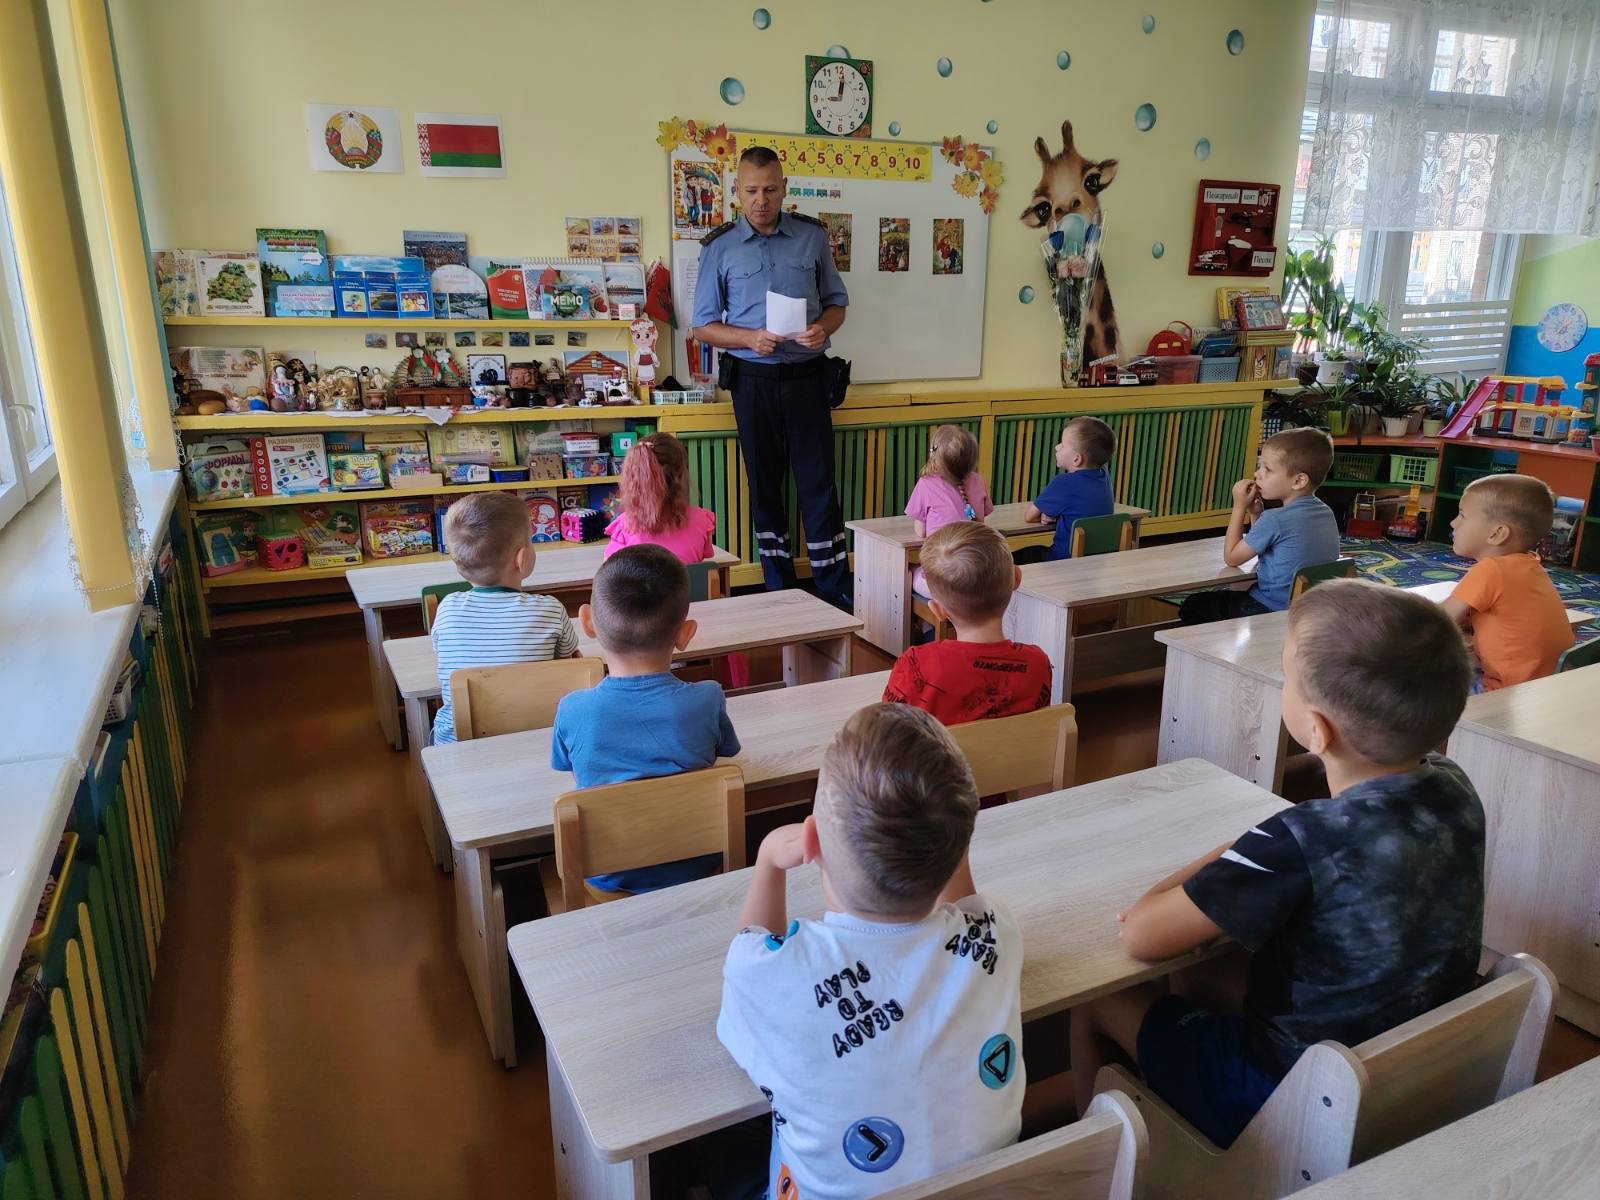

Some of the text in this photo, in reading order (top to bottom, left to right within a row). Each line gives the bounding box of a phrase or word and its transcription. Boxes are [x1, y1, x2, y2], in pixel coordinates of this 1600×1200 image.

[823, 69, 831, 77] 11
[835, 66, 844, 75] 12
[813, 80, 823, 88] 10
[859, 83, 863, 91] 2
[813, 95, 818, 103] 9
[862, 97, 866, 105] 3
[817, 110, 821, 118] 8
[827, 121, 831, 129] 7
[850, 122, 855, 130] 5
[779, 150, 920, 169] 3 4 5 6 7 8 9 10
[204, 454, 246, 471] ФОРМЫ
[560, 496, 577, 509] IQ
[814, 960, 871, 1008] PLAY
[837, 990, 874, 1020] TO
[832, 998, 904, 1058] READY
